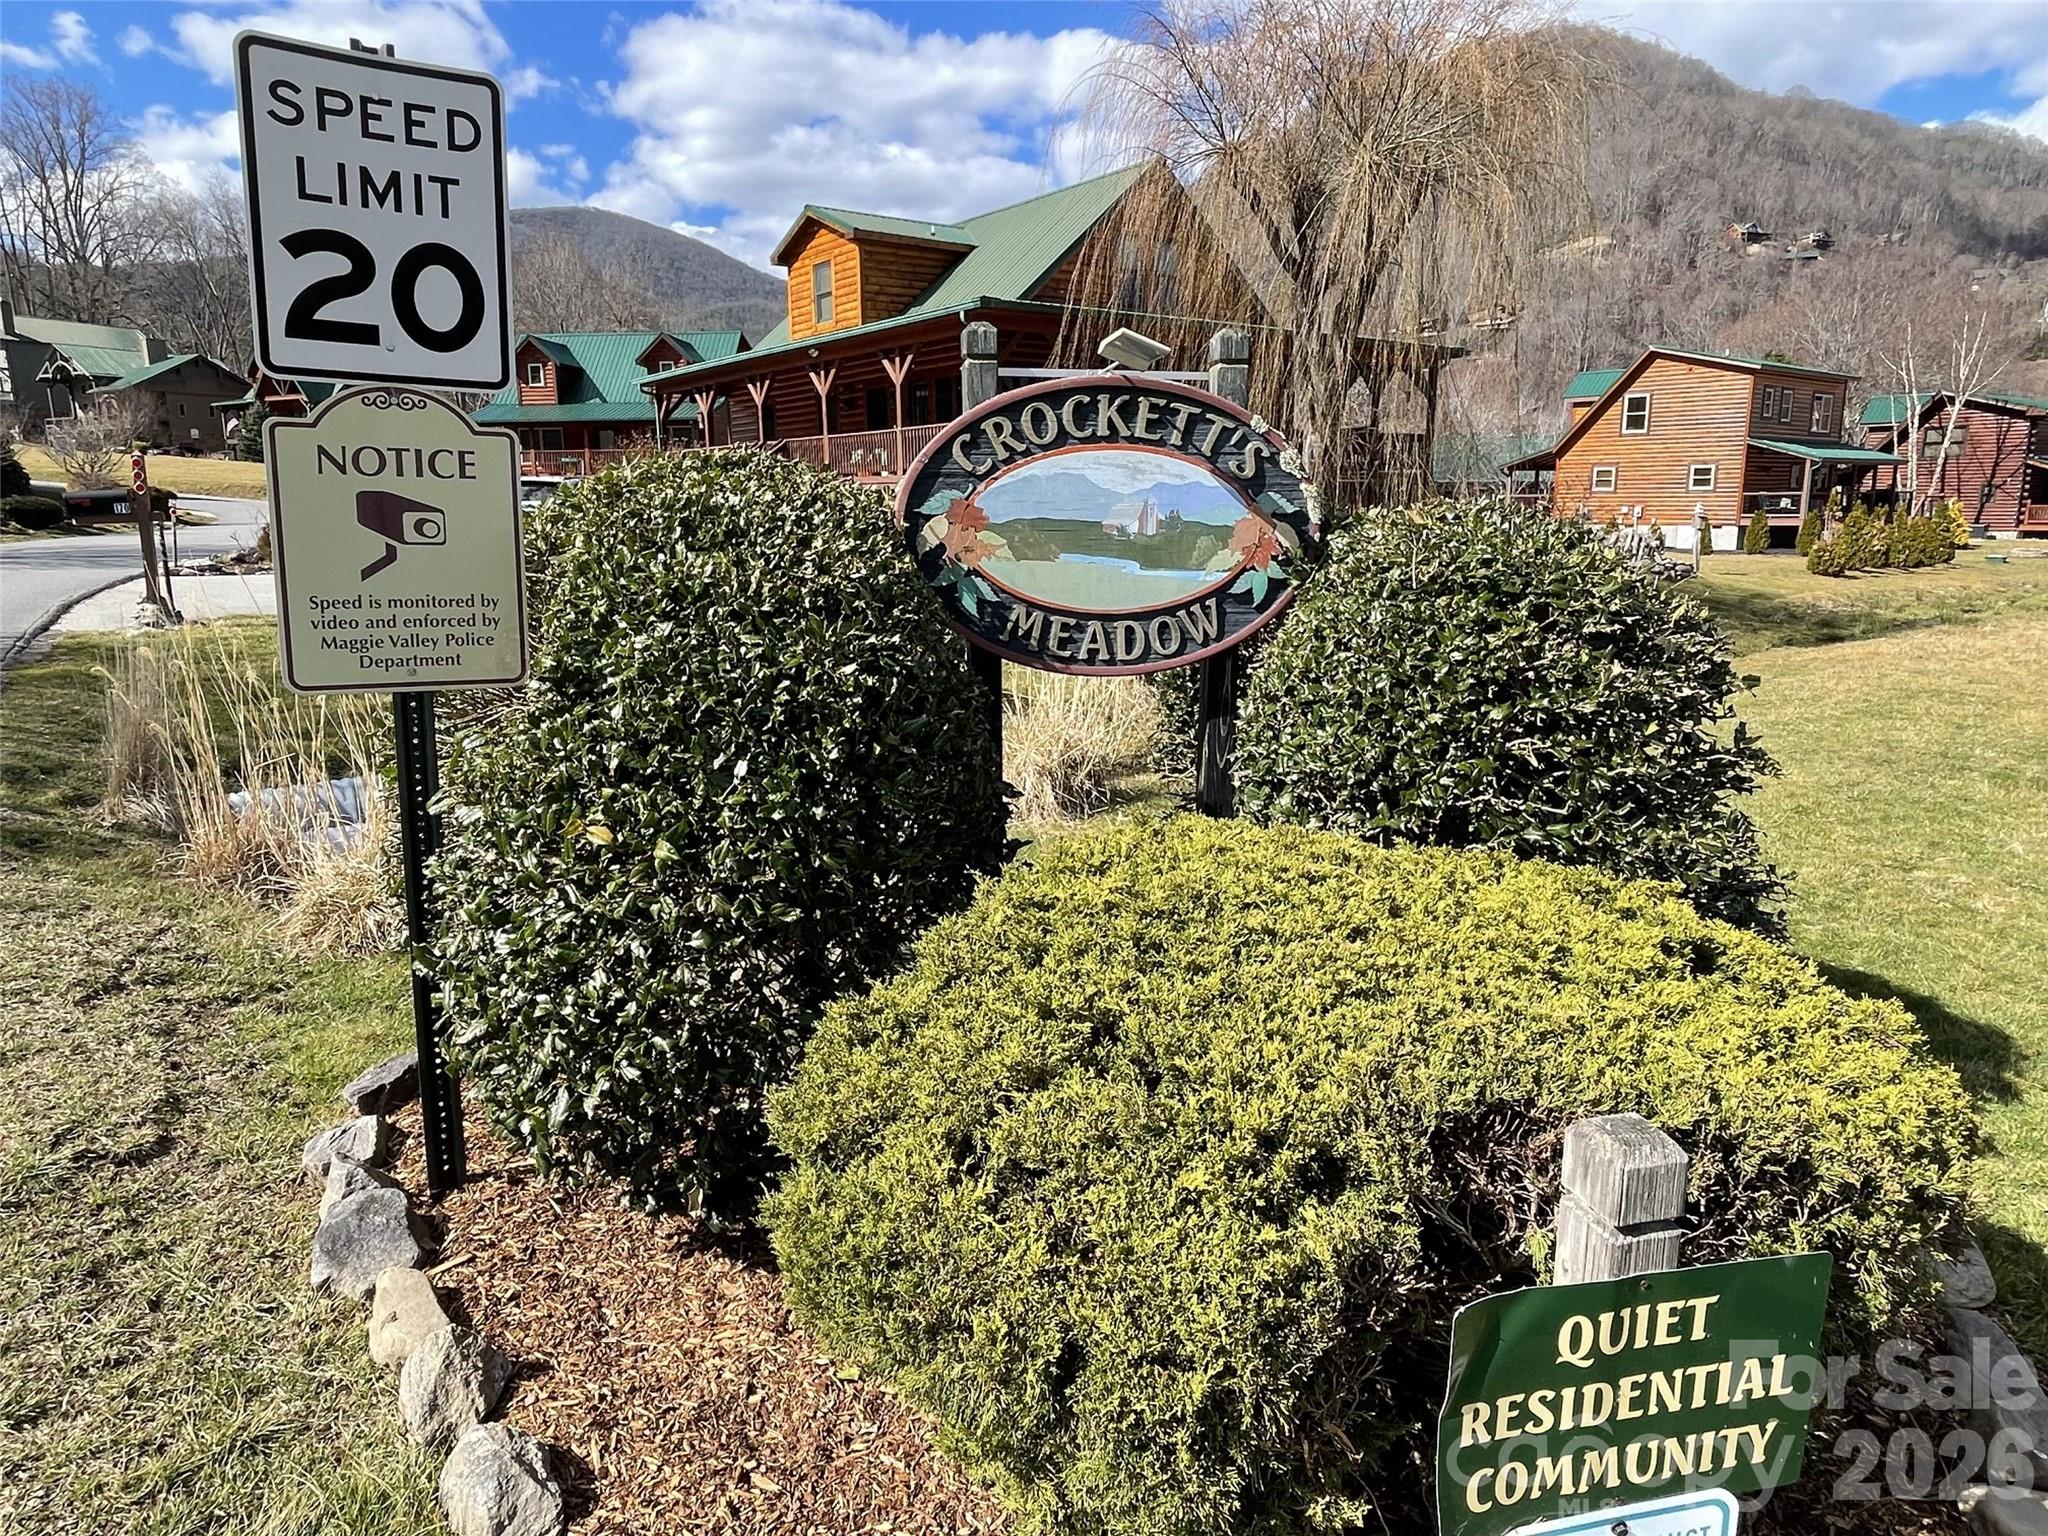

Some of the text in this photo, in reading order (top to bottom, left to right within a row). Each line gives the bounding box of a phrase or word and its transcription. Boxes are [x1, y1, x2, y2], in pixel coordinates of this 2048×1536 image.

[266, 79, 482, 153] SPEED
[295, 155, 461, 219] LIMIT
[278, 228, 486, 354] 20
[316, 444, 477, 480] NOTICE
[952, 393, 1270, 480] CROCKETT'S
[309, 593, 500, 614] Speed is monitored by
[310, 613, 501, 631] video and enforced by
[998, 597, 1220, 662] MEADOW
[320, 632, 495, 654] Maggie Valley Police
[359, 653, 462, 672] Department
[1555, 1294, 1721, 1368] QUIET
[1459, 1353, 1794, 1449] RESIDENTIAL
[1465, 1419, 1780, 1514] COMMUNITY
